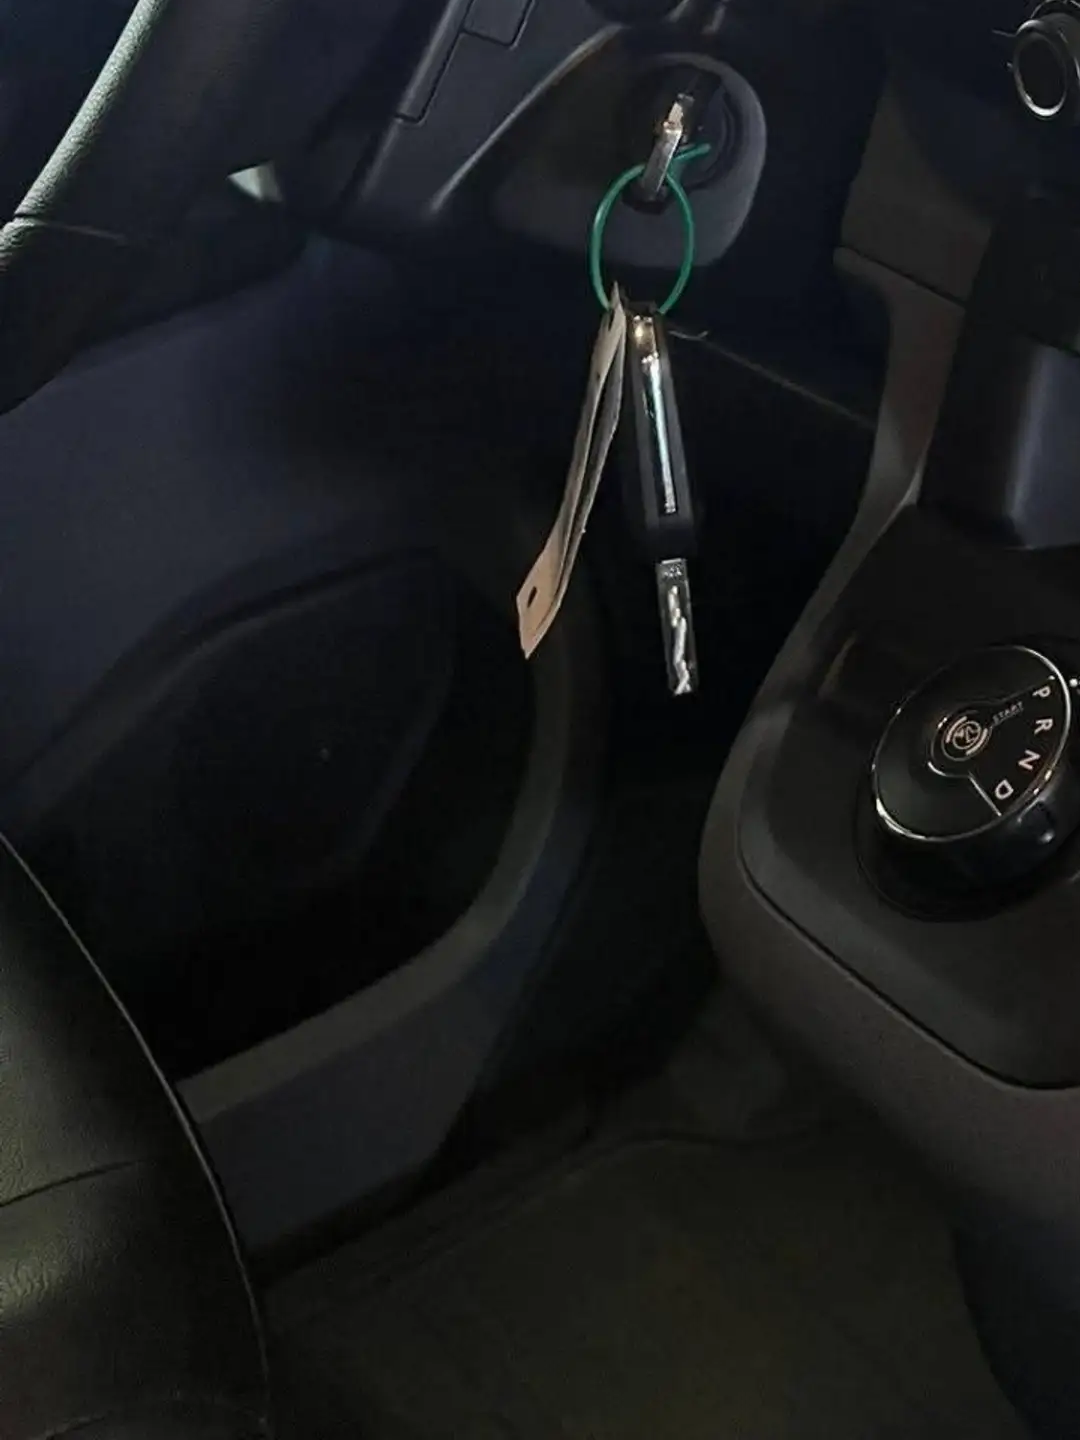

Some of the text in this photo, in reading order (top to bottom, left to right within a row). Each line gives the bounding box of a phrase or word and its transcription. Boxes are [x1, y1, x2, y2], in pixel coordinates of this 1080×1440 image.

[995, 685, 1053, 800] P R N D
